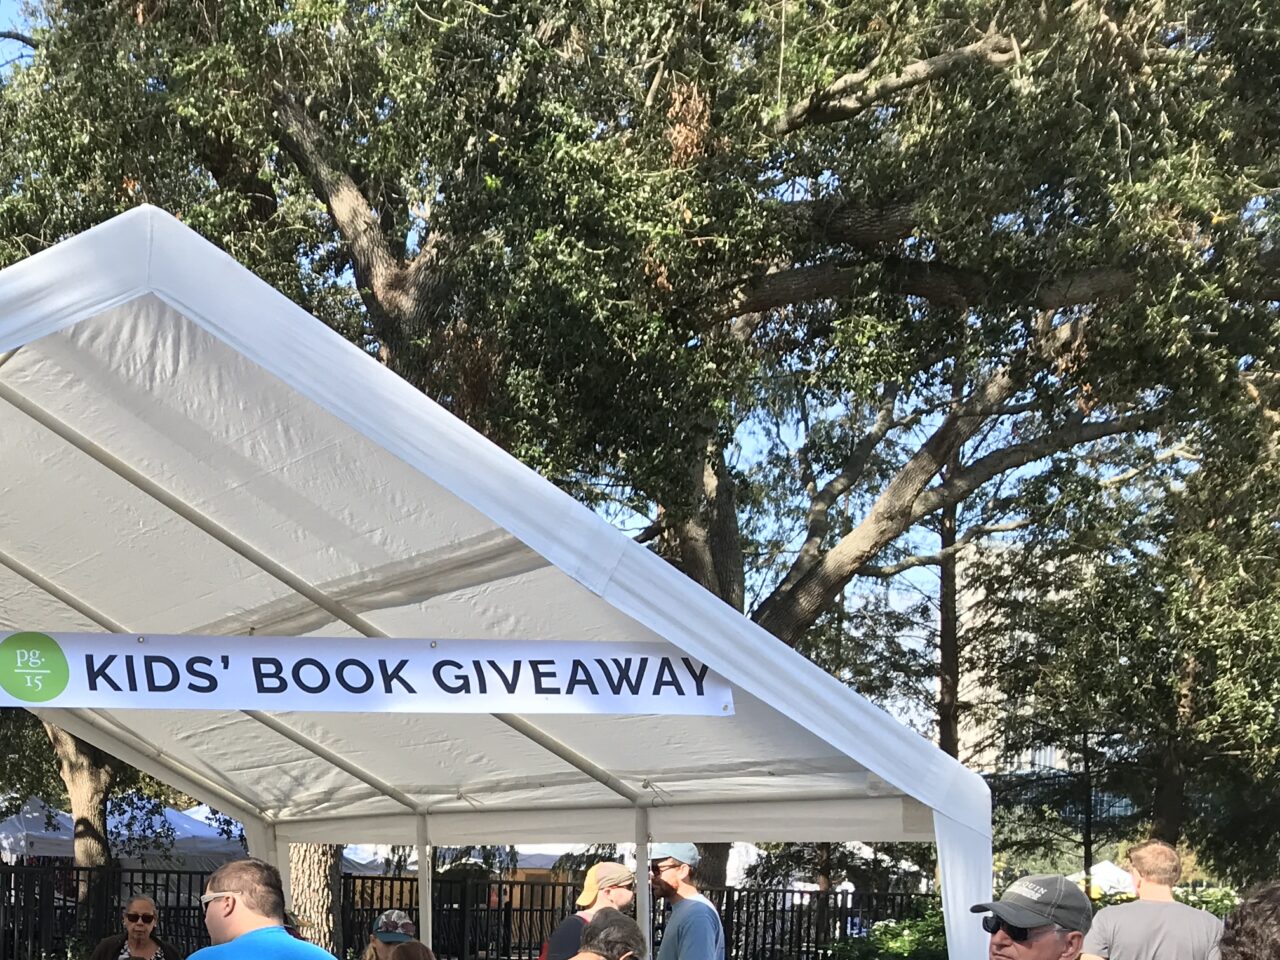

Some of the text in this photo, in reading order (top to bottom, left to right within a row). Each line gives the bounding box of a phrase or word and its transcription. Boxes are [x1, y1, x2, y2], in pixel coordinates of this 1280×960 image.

[16, 647, 46, 667] pg.
[24, 674, 43, 690] 15
[85, 654, 709, 696] KIDS' BOOK GIVEAWAY
